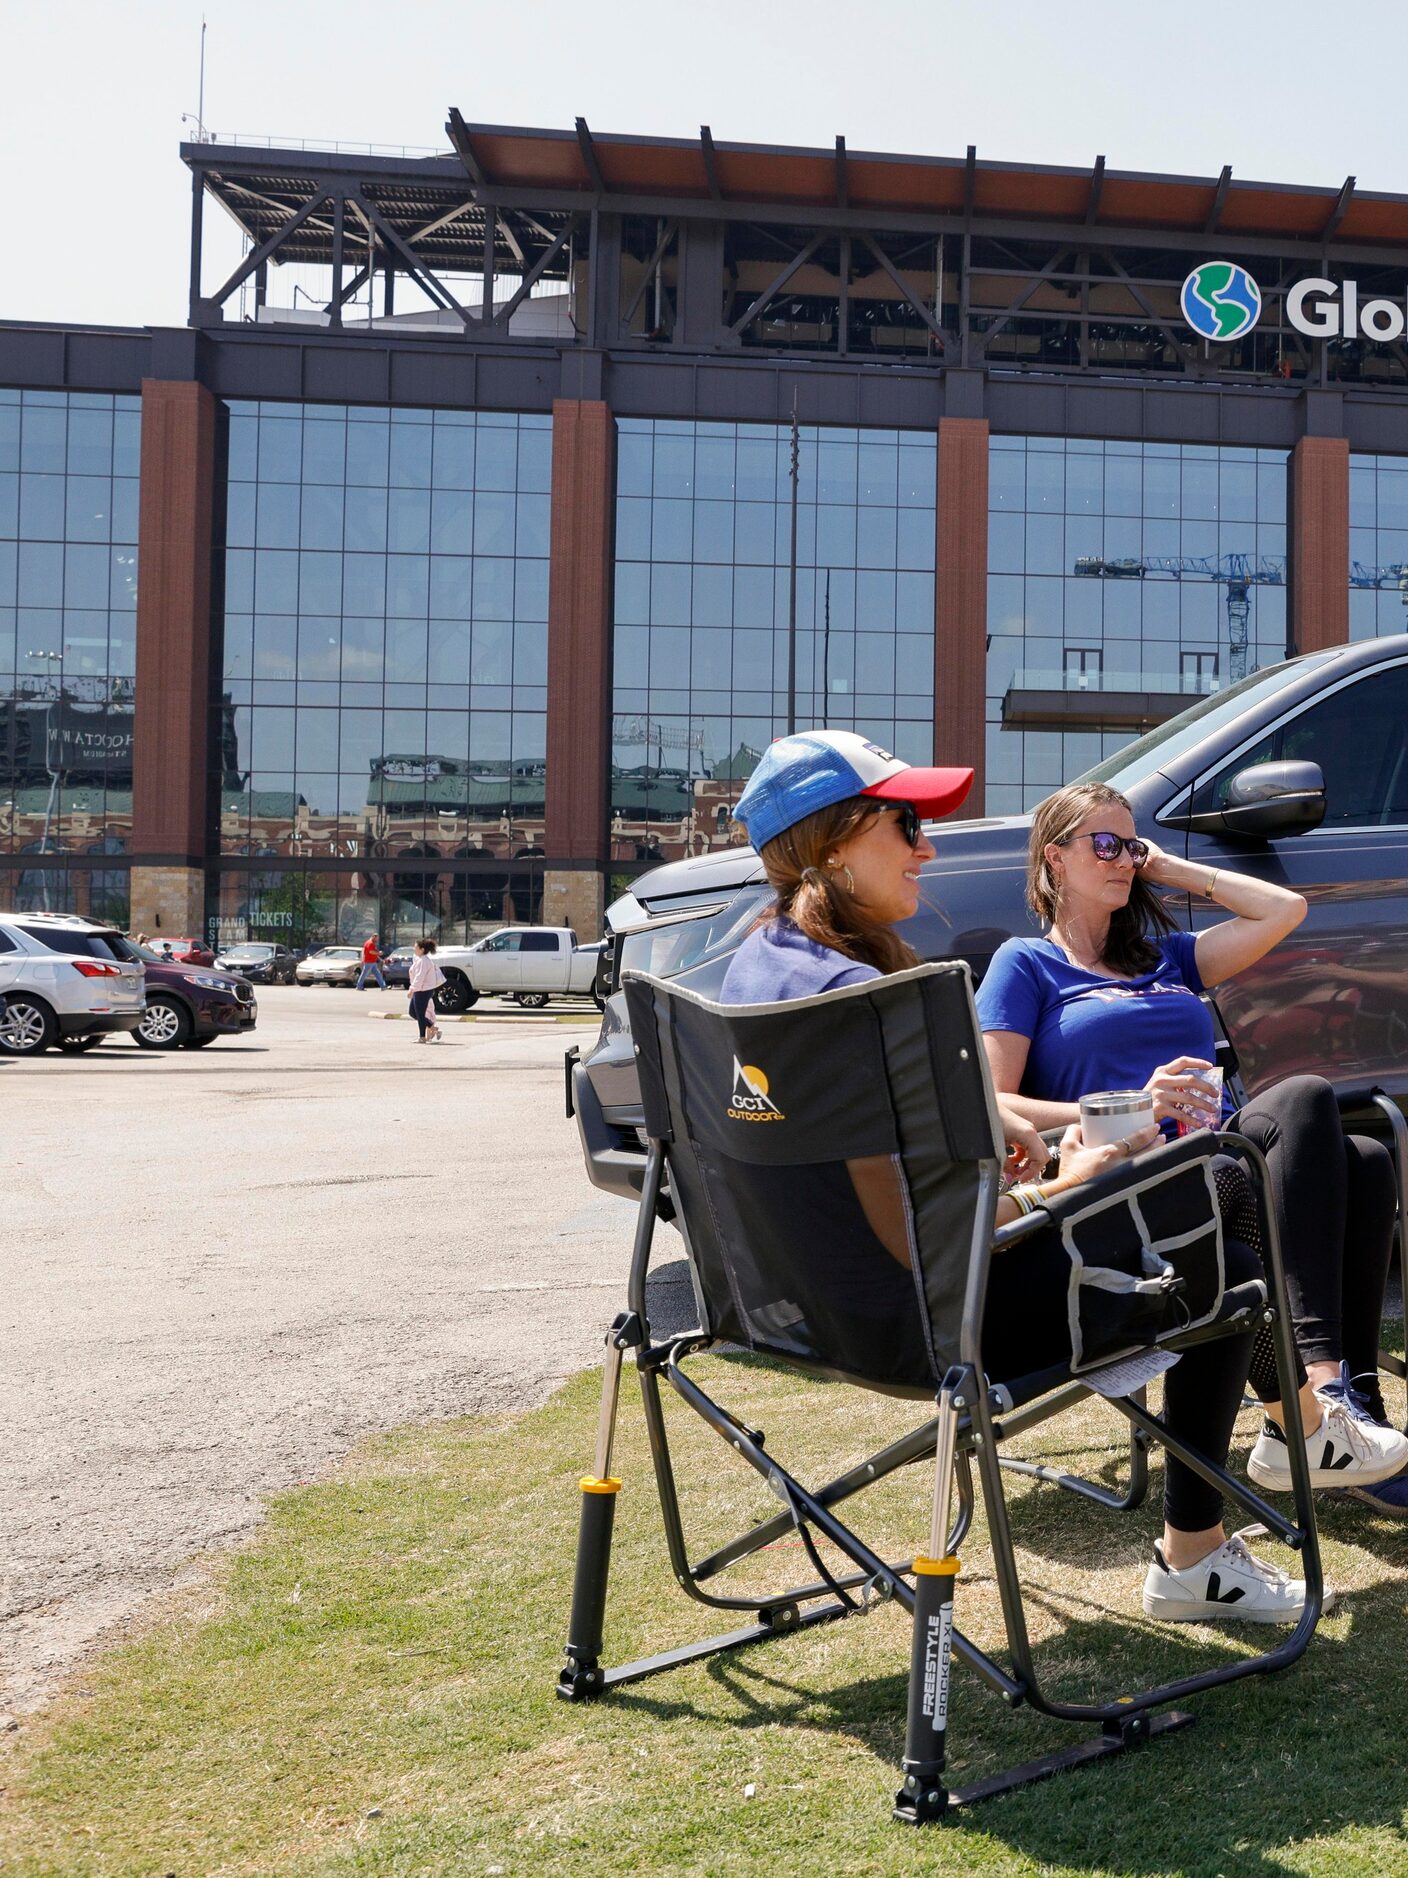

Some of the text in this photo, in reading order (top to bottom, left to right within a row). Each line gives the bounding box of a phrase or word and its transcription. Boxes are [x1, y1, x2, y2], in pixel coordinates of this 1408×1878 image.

[209, 917, 246, 928] GRAND
[249, 911, 293, 927] TICKETS
[732, 1094, 766, 1110] GCI
[922, 1615, 940, 1716] FREESTYLE
[938, 1641, 951, 1717] ROCKER
